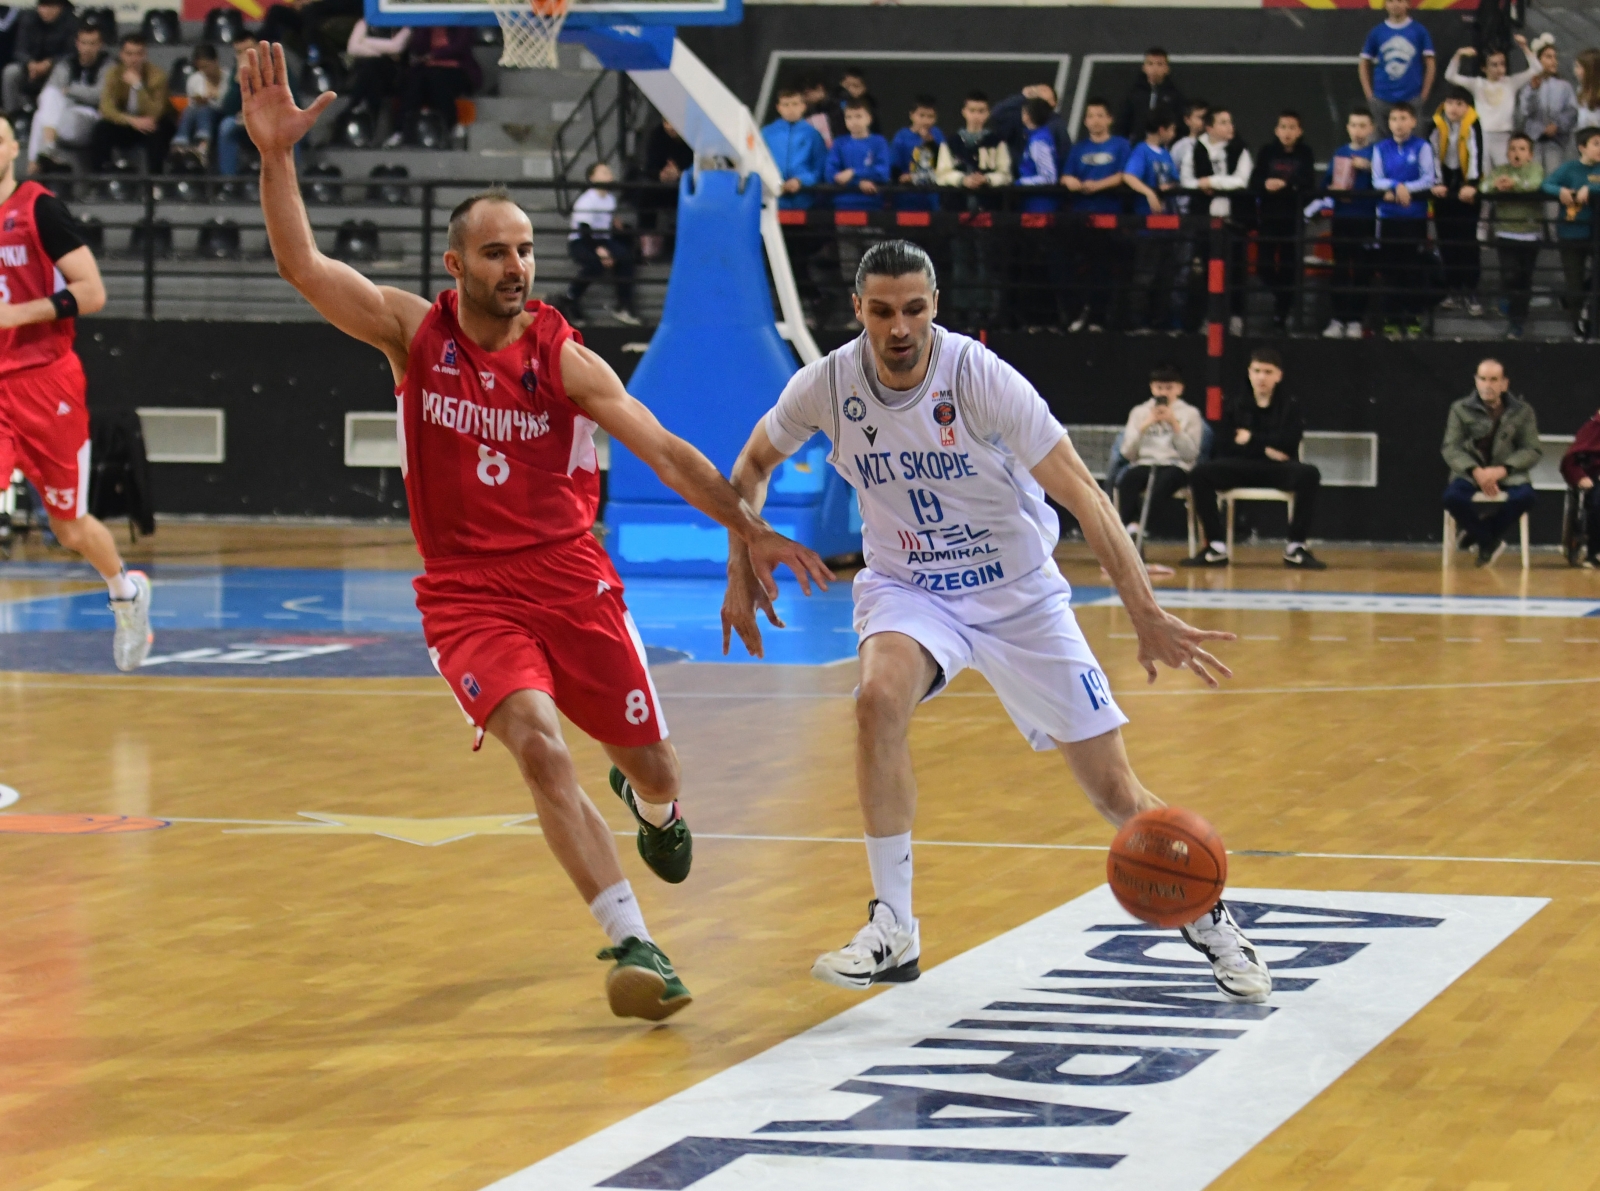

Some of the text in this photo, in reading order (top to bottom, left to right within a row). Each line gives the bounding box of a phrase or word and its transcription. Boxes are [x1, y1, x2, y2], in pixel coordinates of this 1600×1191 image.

[476, 443, 510, 486] 8
[854, 451, 978, 489] MZT SKOPJE
[908, 488, 944, 525] 19
[906, 543, 999, 565] ADMIRAL
[928, 561, 1005, 592] ZEGIN
[624, 688, 650, 726] 8
[1079, 668, 1109, 711] 19
[592, 899, 1446, 1191] ADMIRAL
